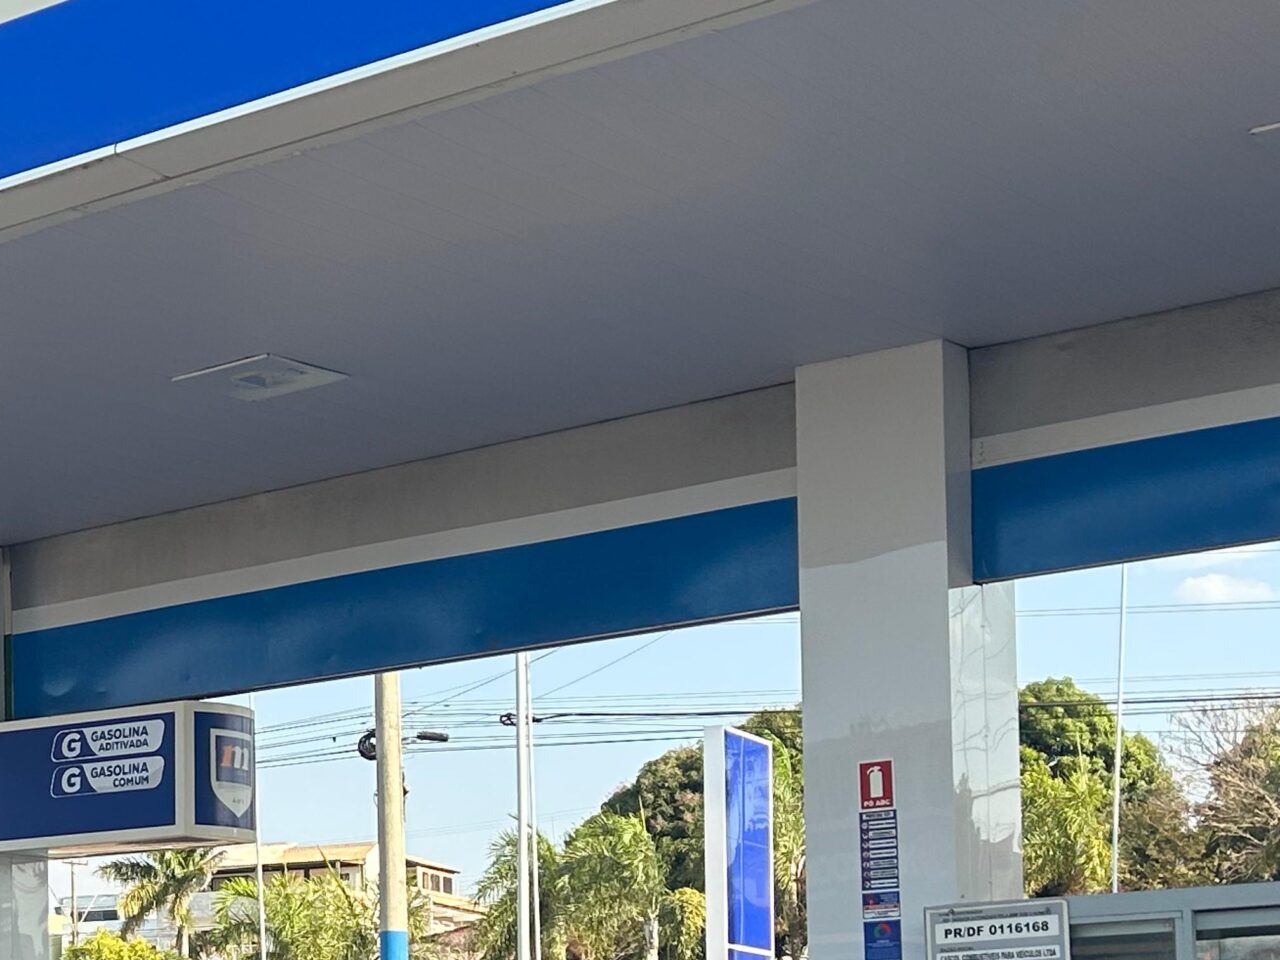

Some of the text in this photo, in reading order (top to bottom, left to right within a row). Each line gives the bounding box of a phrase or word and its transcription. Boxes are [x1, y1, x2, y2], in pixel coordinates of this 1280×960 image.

[91, 725, 149, 742] GASOLINA
[61, 732, 81, 758] G
[98, 738, 149, 752] ADITIVADA
[90, 762, 149, 778] GASOLINA
[61, 767, 81, 793] G
[112, 775, 150, 788] COMUM
[944, 921, 1049, 939] PR/DF 0116168
